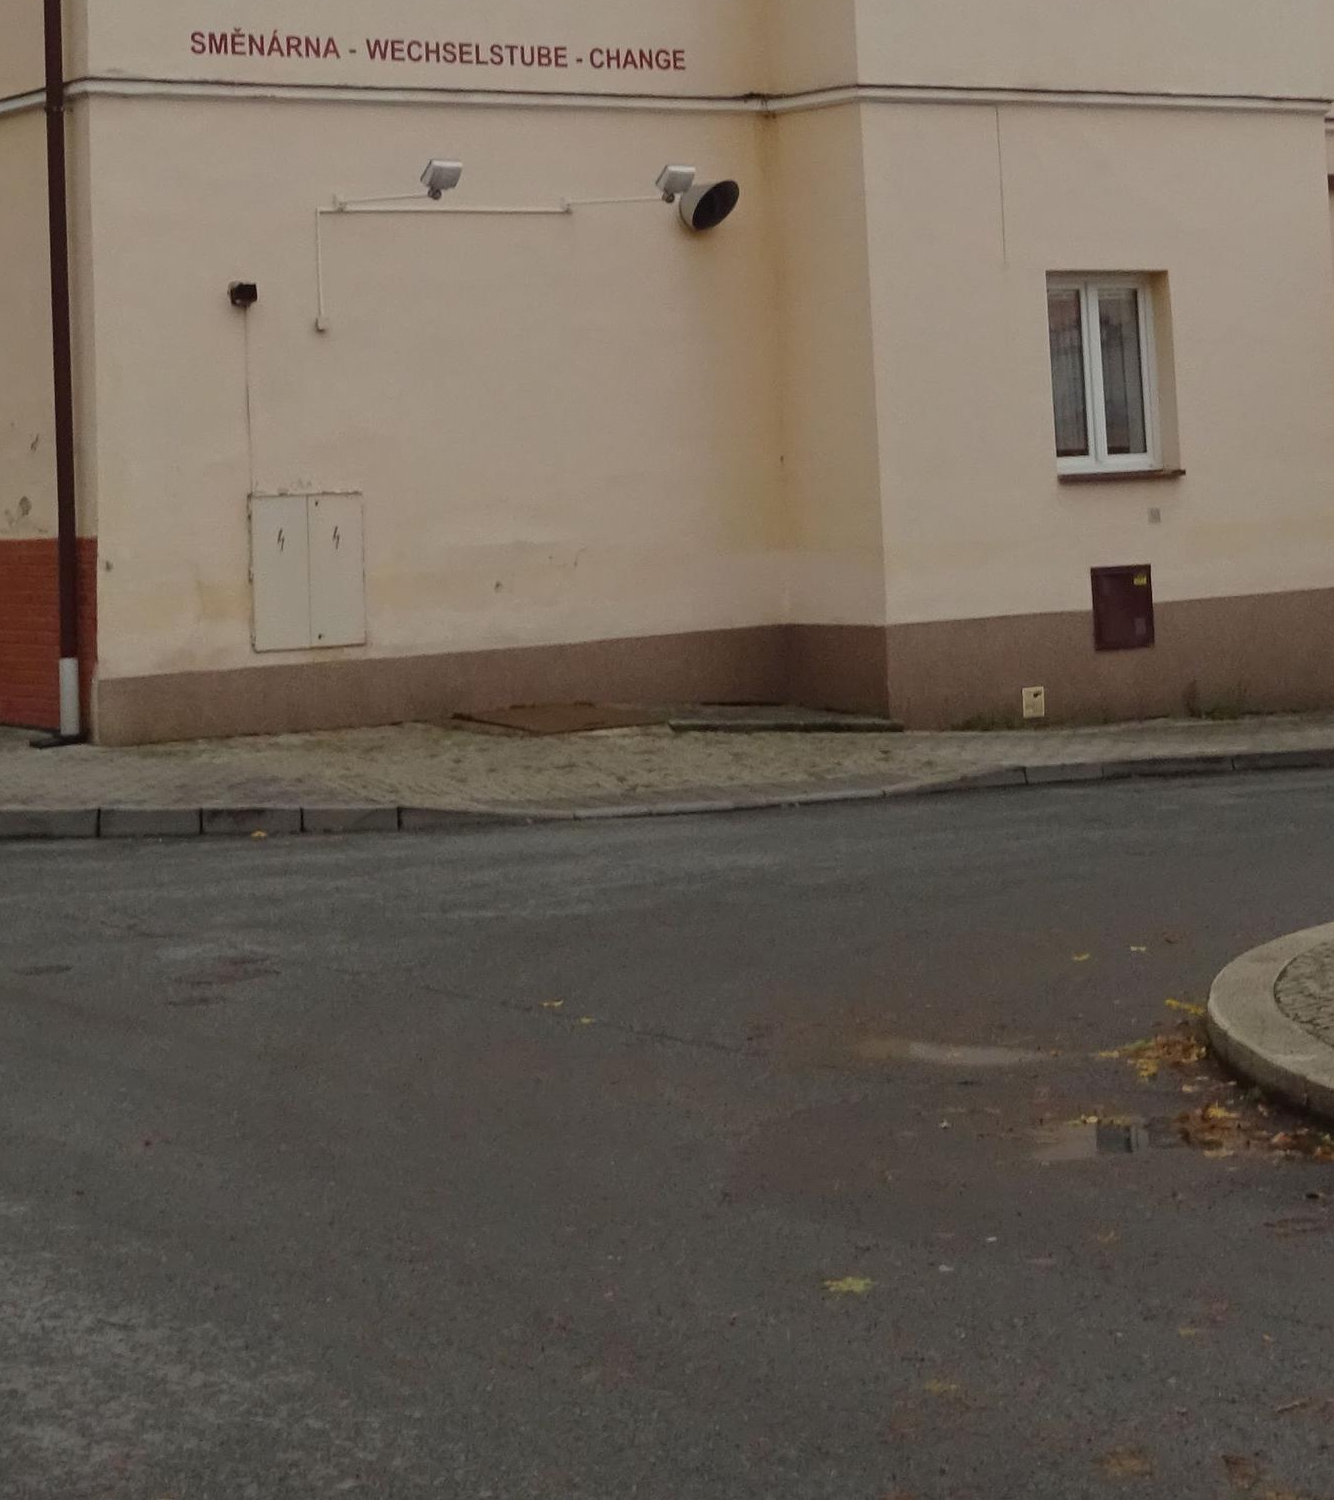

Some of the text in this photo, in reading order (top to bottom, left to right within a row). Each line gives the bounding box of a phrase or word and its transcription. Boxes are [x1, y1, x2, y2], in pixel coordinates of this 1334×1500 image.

[190, 28, 341, 59] SMĚNÁRNA
[366, 38, 568, 68] WECHSELSTUBE
[589, 47, 687, 71] CHANGE
